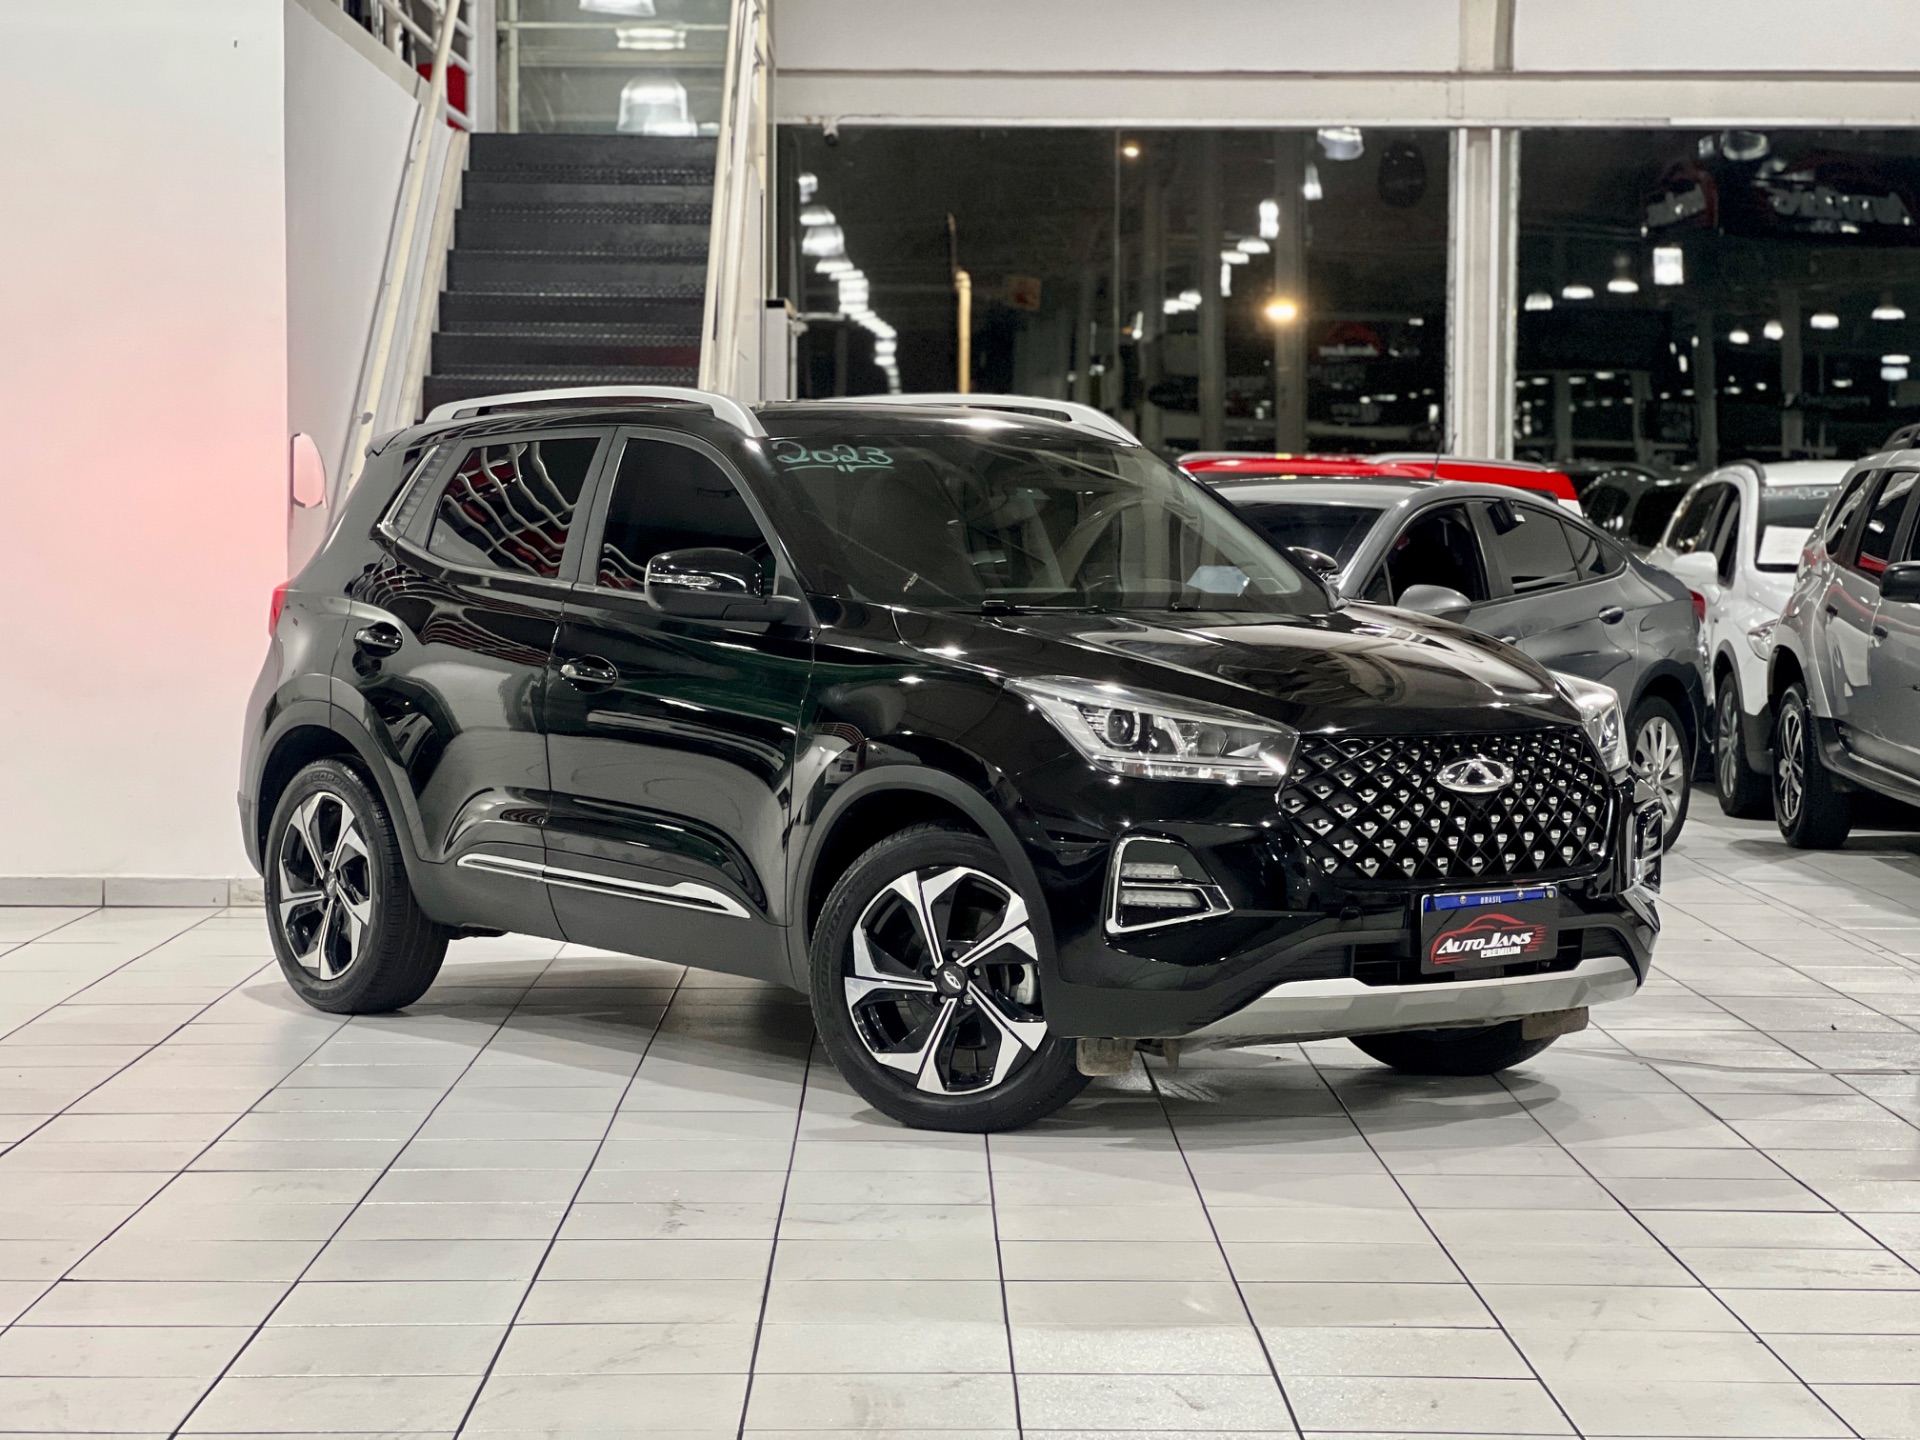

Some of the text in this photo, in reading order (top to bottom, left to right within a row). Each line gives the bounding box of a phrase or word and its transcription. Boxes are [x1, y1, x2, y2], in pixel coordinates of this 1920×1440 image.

[772, 441, 893, 464] 2023
[1480, 895, 1502, 905] BRASIL
[1481, 946, 1521, 958] PREMIUM
